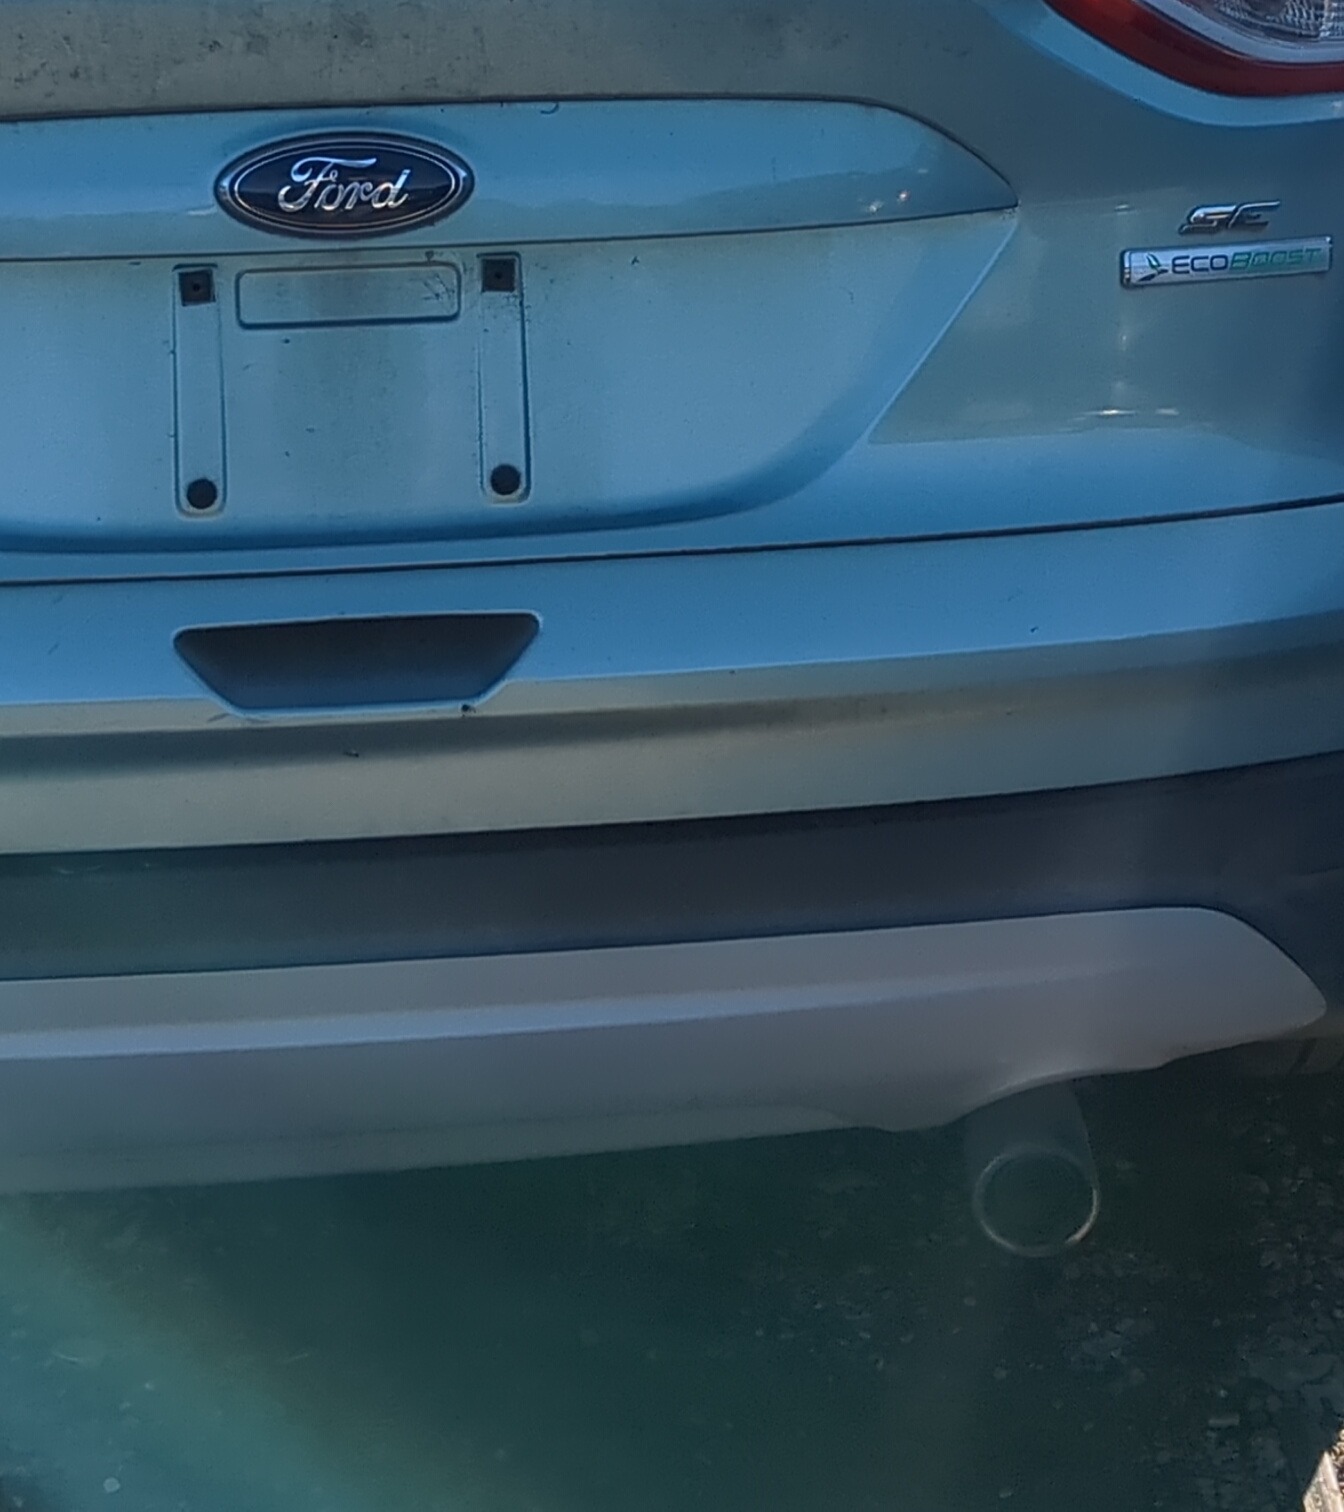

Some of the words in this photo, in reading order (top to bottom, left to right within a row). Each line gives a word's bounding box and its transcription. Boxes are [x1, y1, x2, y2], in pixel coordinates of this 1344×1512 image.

[277, 155, 413, 213] Ford
[1177, 198, 1282, 235] SE
[1170, 246, 1324, 275] ECOBOOST
